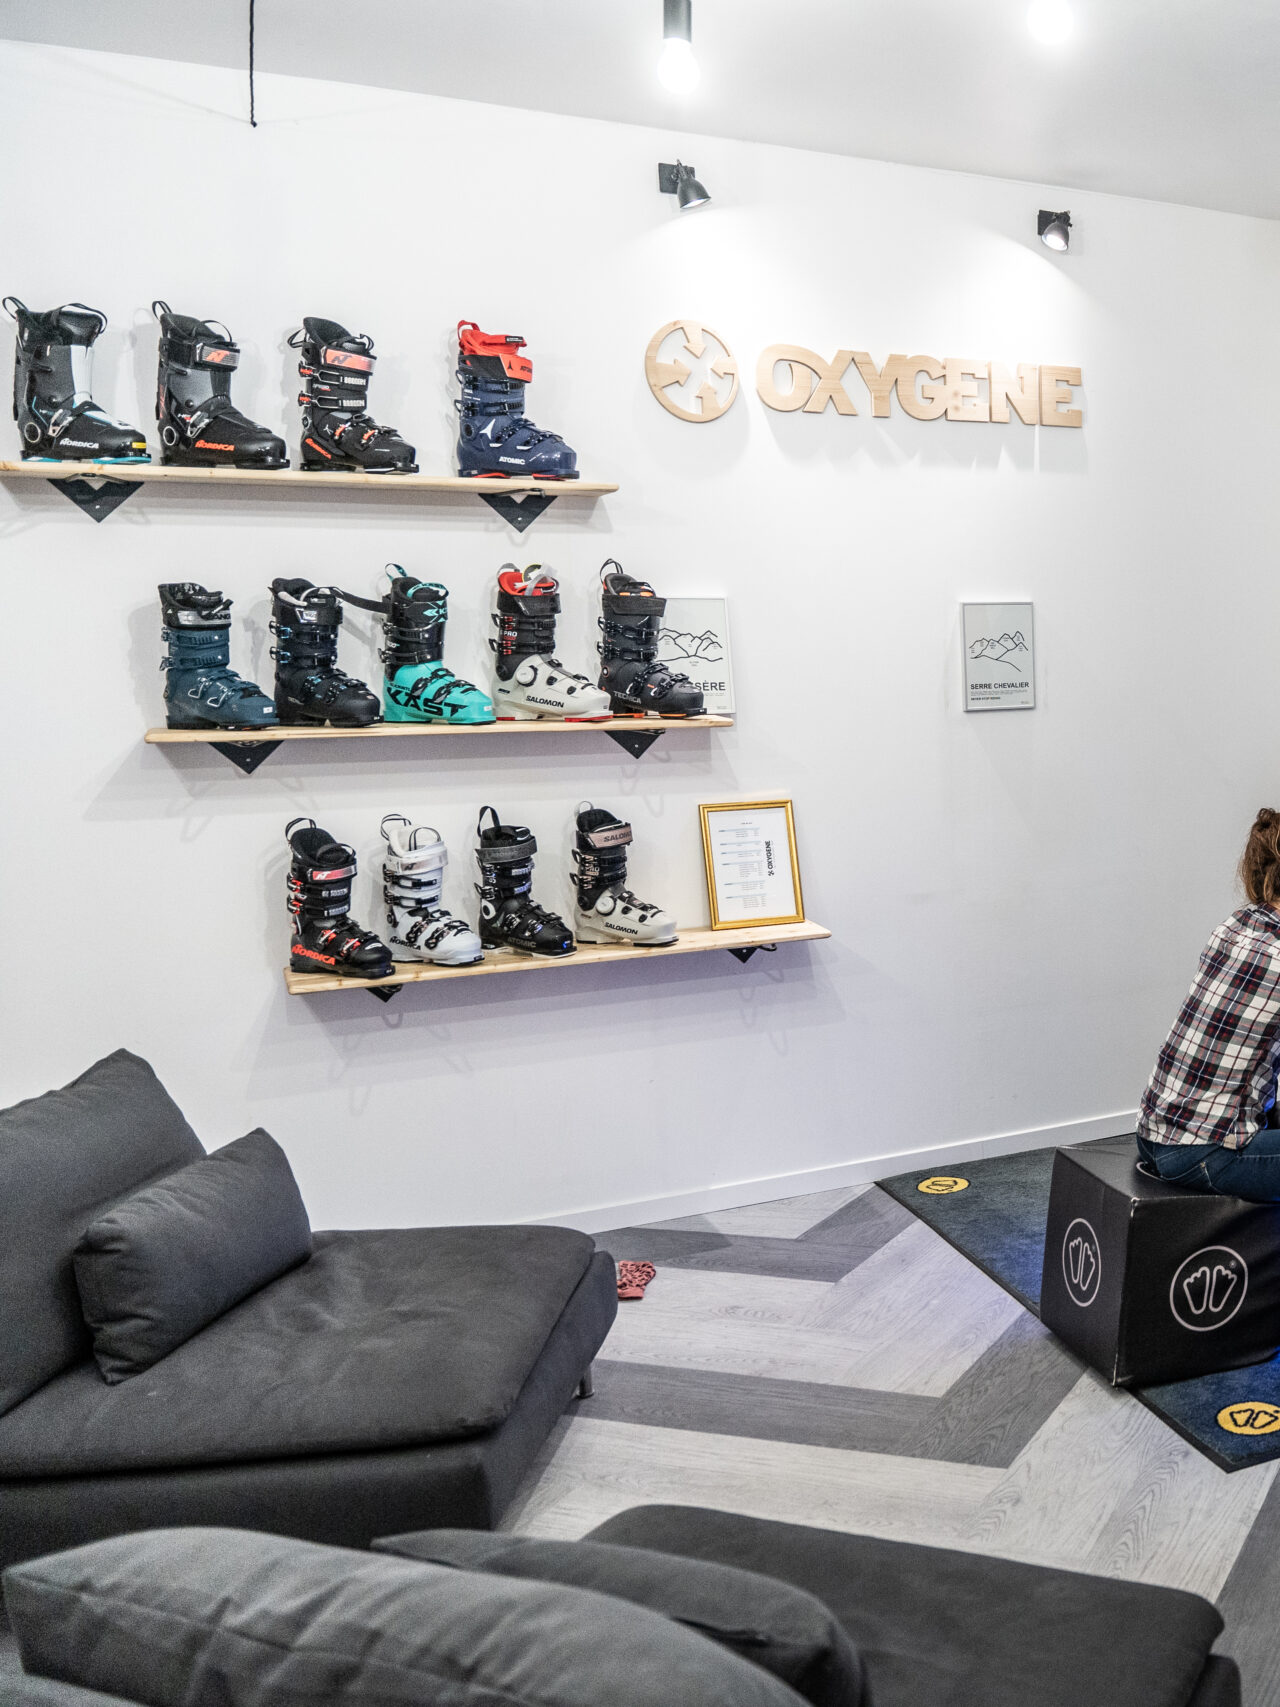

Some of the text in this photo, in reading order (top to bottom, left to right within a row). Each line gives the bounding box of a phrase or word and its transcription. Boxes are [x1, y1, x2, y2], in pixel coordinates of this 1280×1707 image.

[756, 344, 1082, 428] OXYGENE
[59, 437, 100, 449] NORDICA
[194, 439, 236, 452] NORDICA
[499, 455, 526, 465] ATOMIC
[694, 680, 726, 692] SÈRE
[993, 681, 1030, 689] CHEVALIER
[525, 695, 565, 708] SALOMON
[764, 840, 774, 870] OXYGENE
[604, 921, 638, 935] SALOMON
[388, 934, 421, 951] NORDICA
[507, 935, 537, 948] ATOMIC
[291, 943, 336, 966] NORDICA
